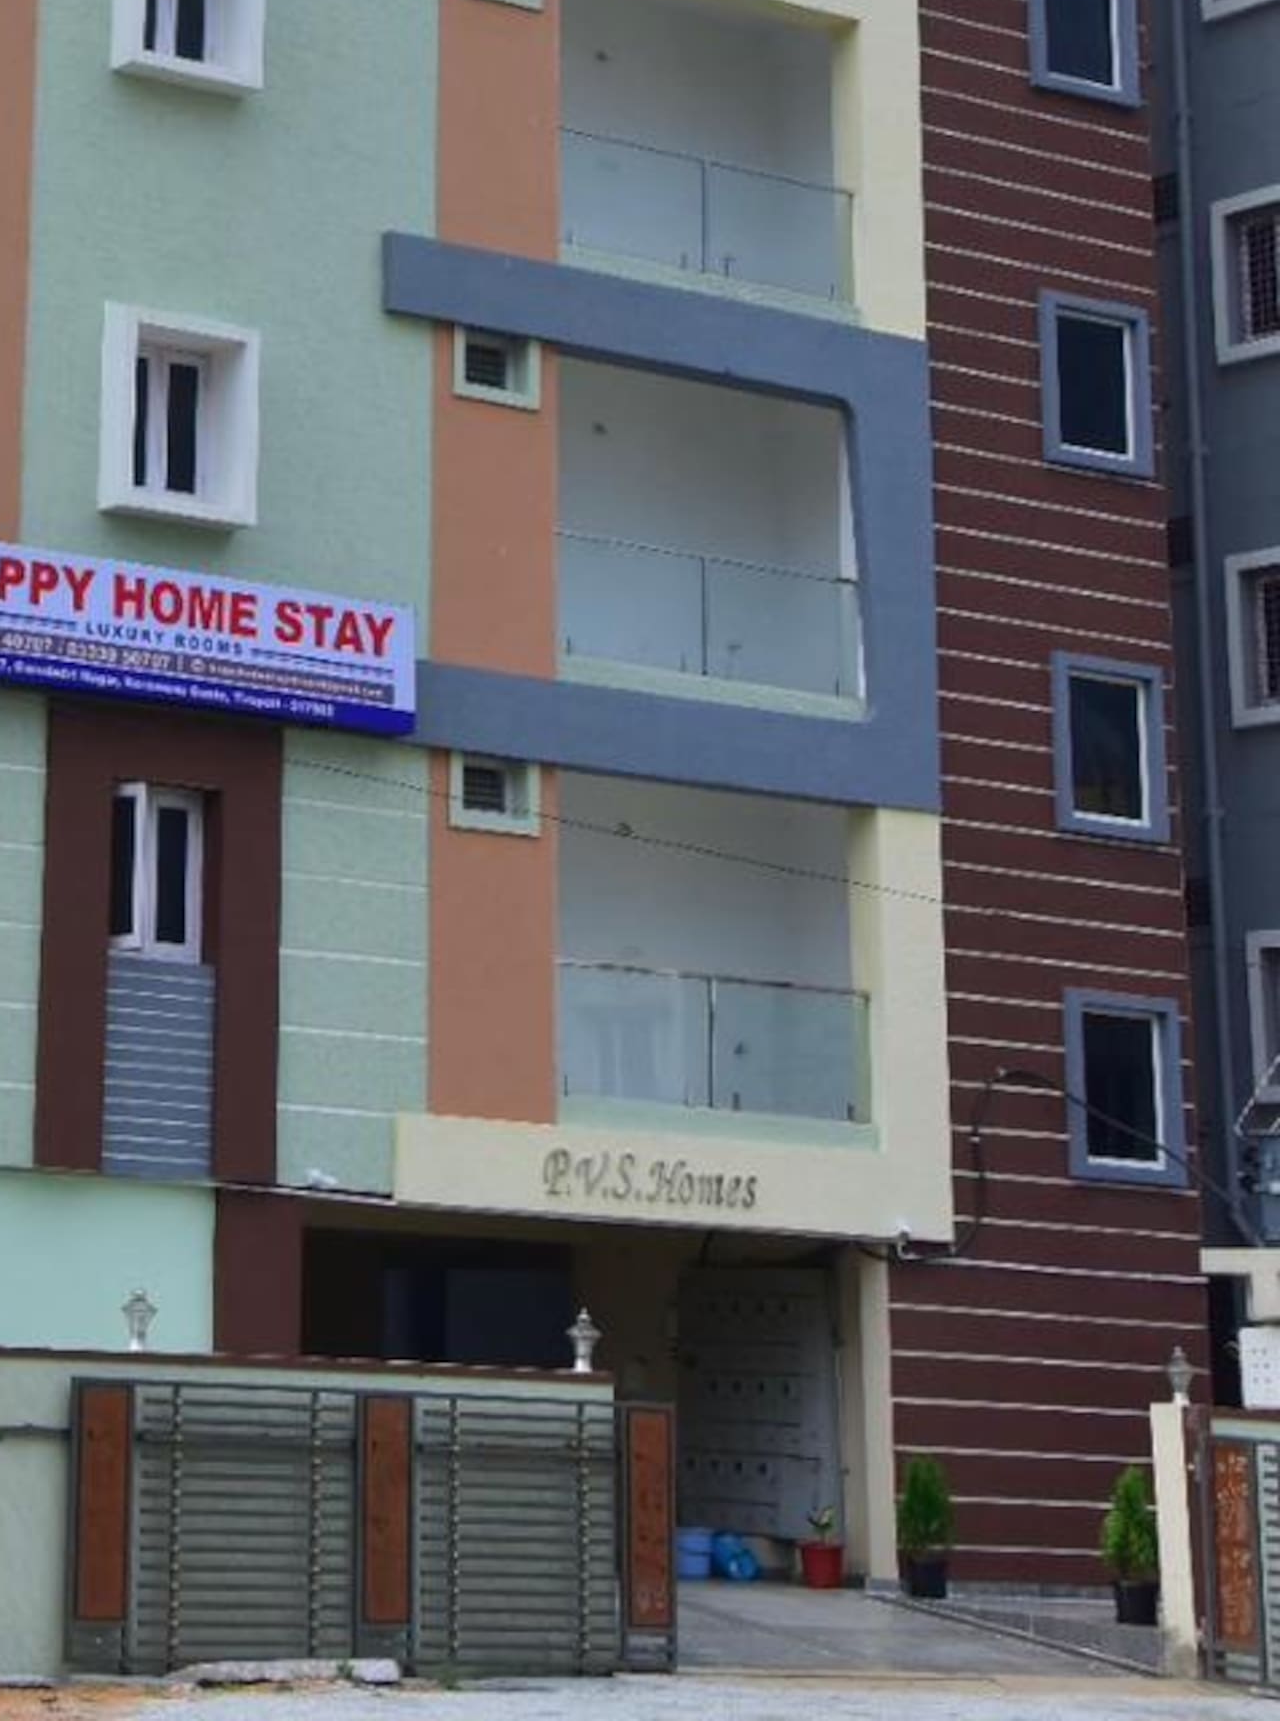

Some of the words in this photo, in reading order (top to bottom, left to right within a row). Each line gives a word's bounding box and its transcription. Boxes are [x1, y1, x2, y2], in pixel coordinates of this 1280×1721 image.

[86, 622, 164, 645] LUXURY
[174, 633, 243, 656] ROOMS
[113, 574, 258, 640] HOME
[273, 599, 395, 658] STAY
